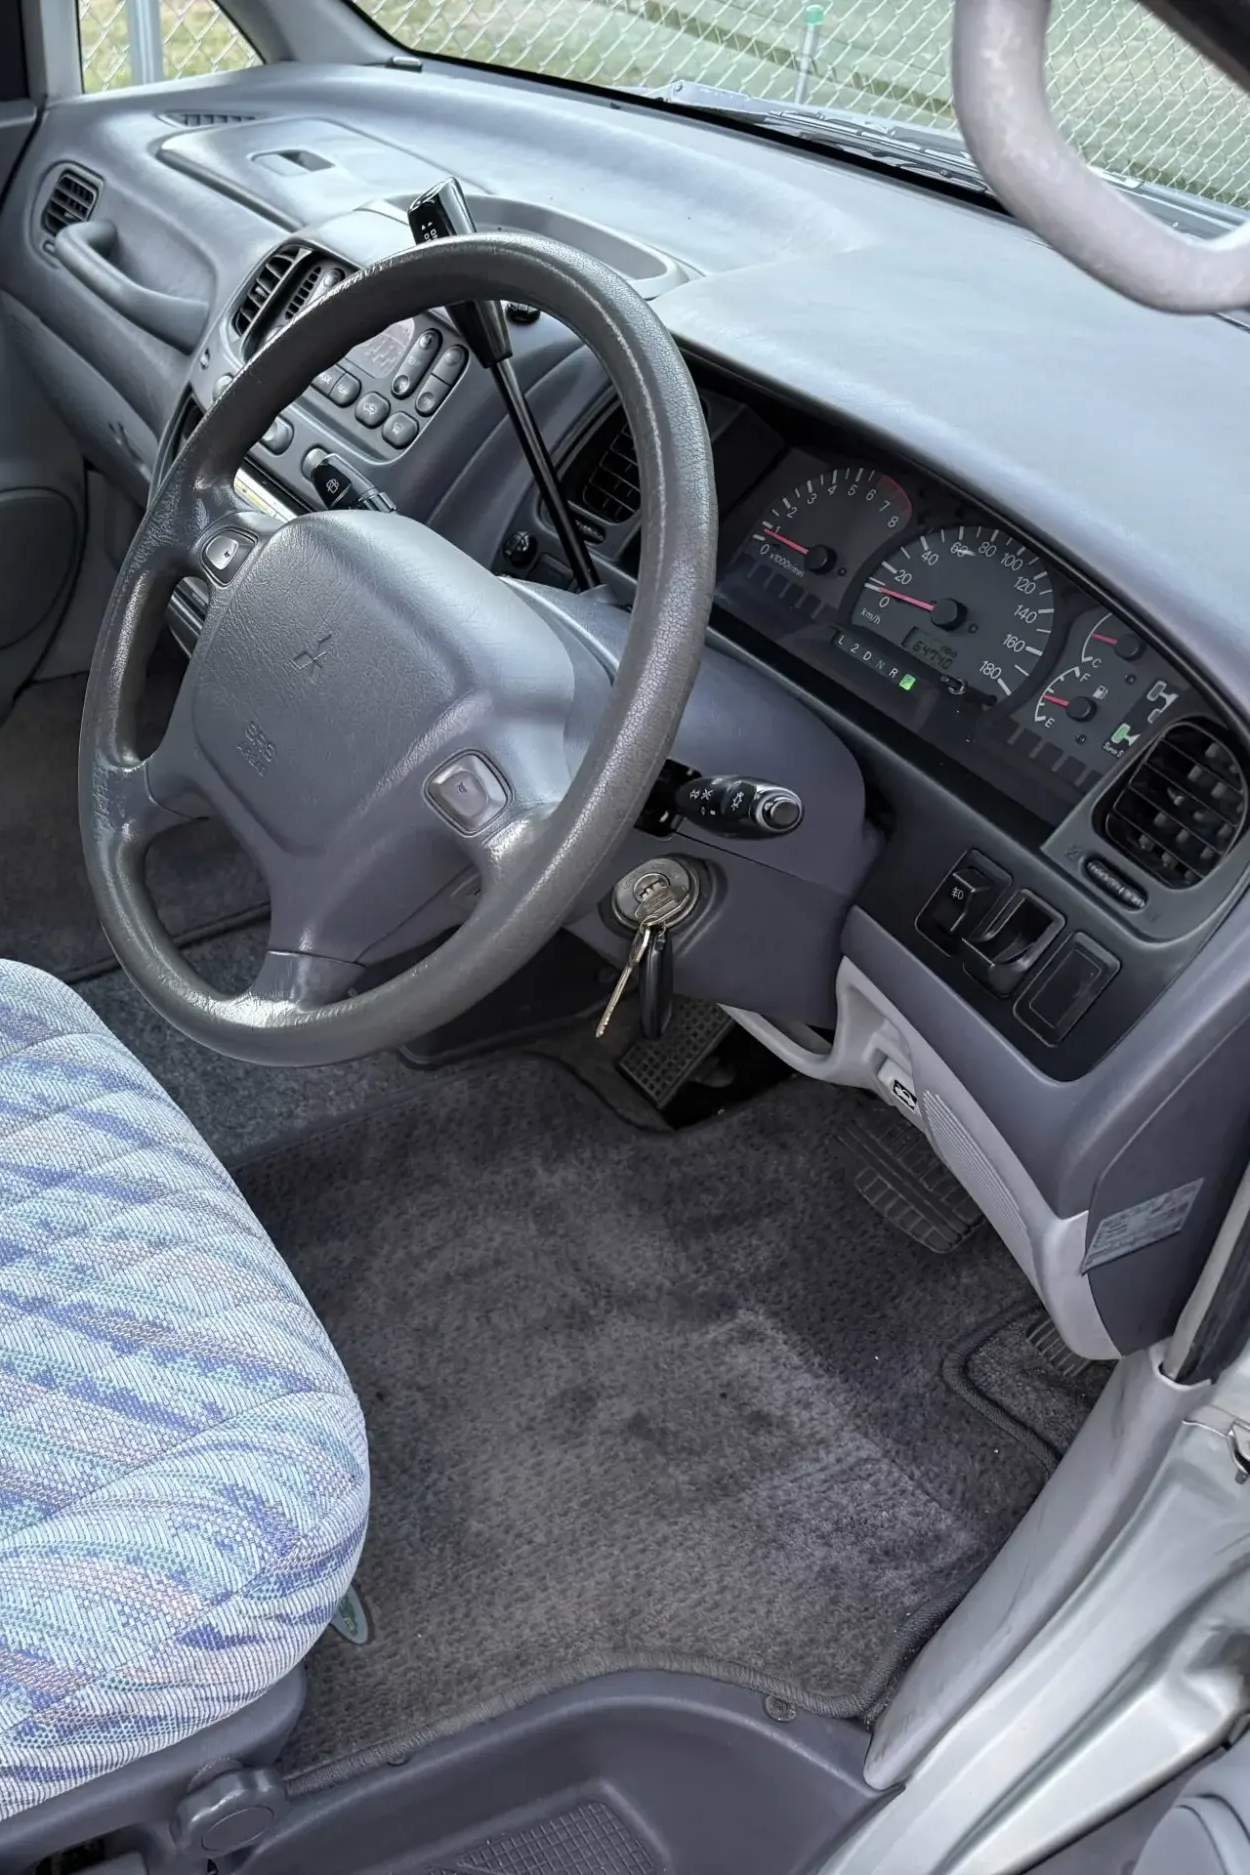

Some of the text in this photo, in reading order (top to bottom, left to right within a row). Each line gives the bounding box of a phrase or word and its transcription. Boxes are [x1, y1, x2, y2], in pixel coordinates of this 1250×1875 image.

[827, 485, 838, 496] 4
[847, 484, 859, 496] 5
[866, 489, 877, 501] 6
[807, 493, 818, 505] 3
[787, 506, 798, 519] 2
[879, 500, 891, 512] 7
[887, 516, 899, 528] 8
[760, 543, 771, 555] 0
[950, 541, 969, 558] 60
[978, 541, 997, 558] 80
[921, 550, 939, 566] 40
[1000, 552, 1024, 571] 100
[894, 569, 913, 585] 20
[1013, 576, 1037, 595] 120
[878, 596, 890, 608] 0
[860, 607, 881, 625] km/h
[1013, 604, 1038, 624] 140
[1002, 633, 1026, 653] 160
[838, 634, 846, 646] L
[850, 643, 860, 654] 2
[863, 651, 872, 661] D
[888, 667, 899, 679] R
[1091, 658, 1102, 668] C
[979, 660, 1002, 680] 180
[1080, 672, 1092, 683] F
[1044, 717, 1056, 729] E
